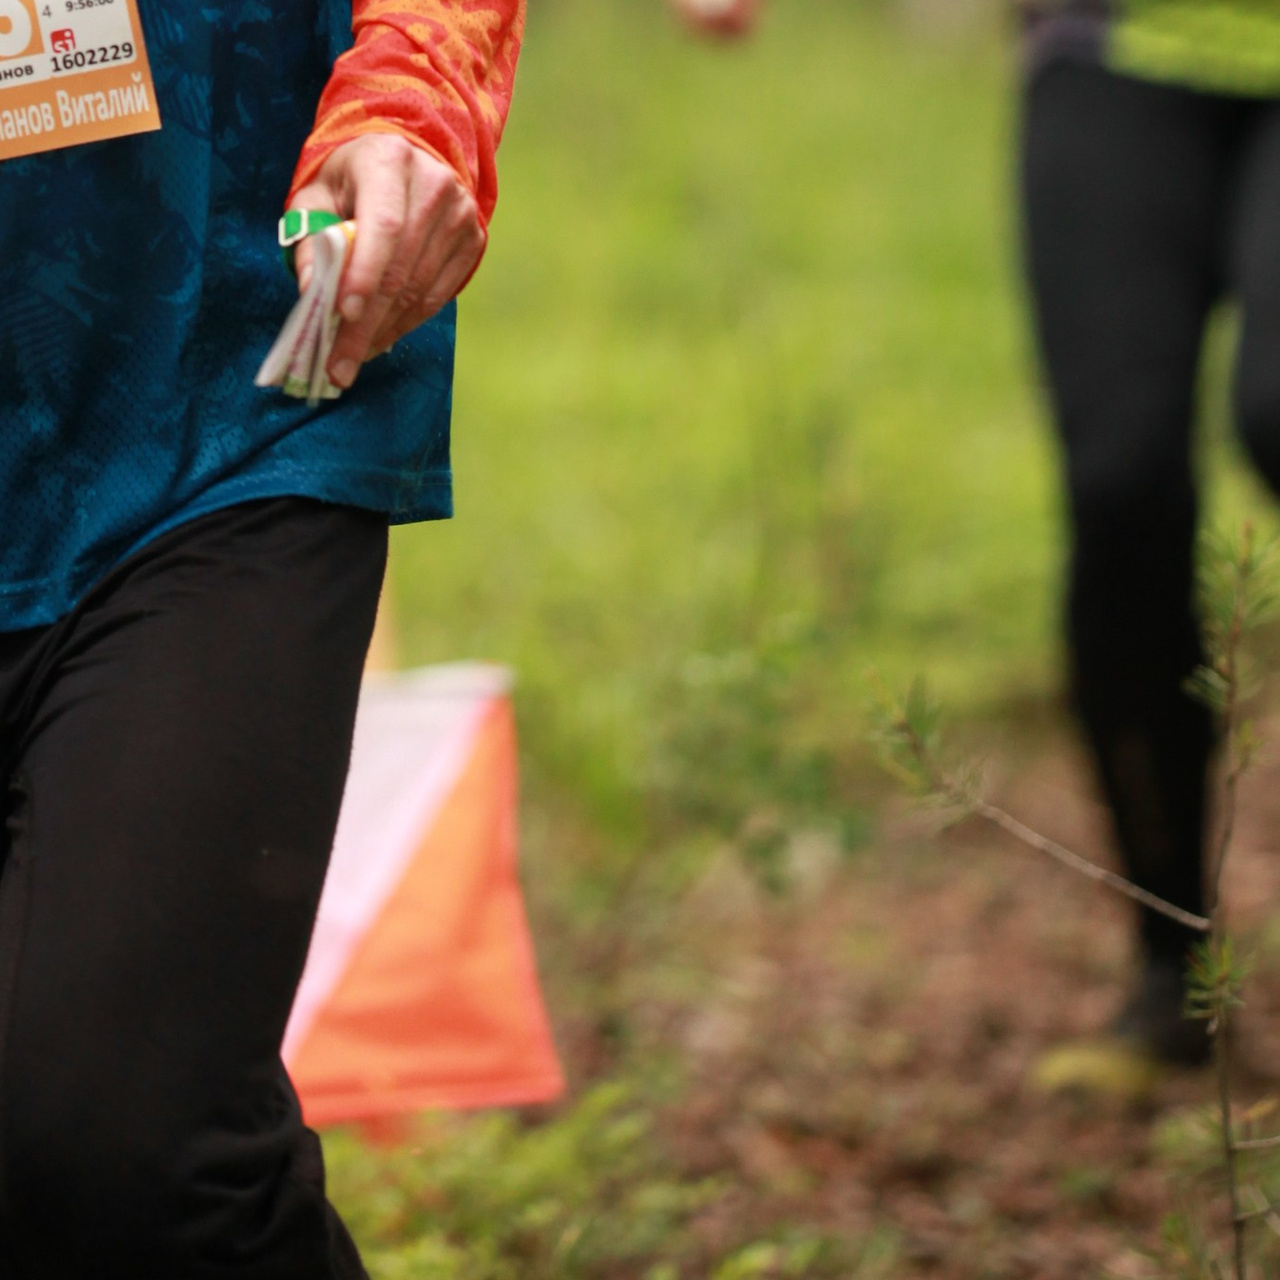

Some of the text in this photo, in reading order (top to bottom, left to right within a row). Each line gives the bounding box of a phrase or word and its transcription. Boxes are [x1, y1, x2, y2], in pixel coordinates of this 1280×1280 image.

[41, 5, 52, 18] 4
[51, 42, 134, 72] 1602229
[57, 71, 150, 128] Виталий
